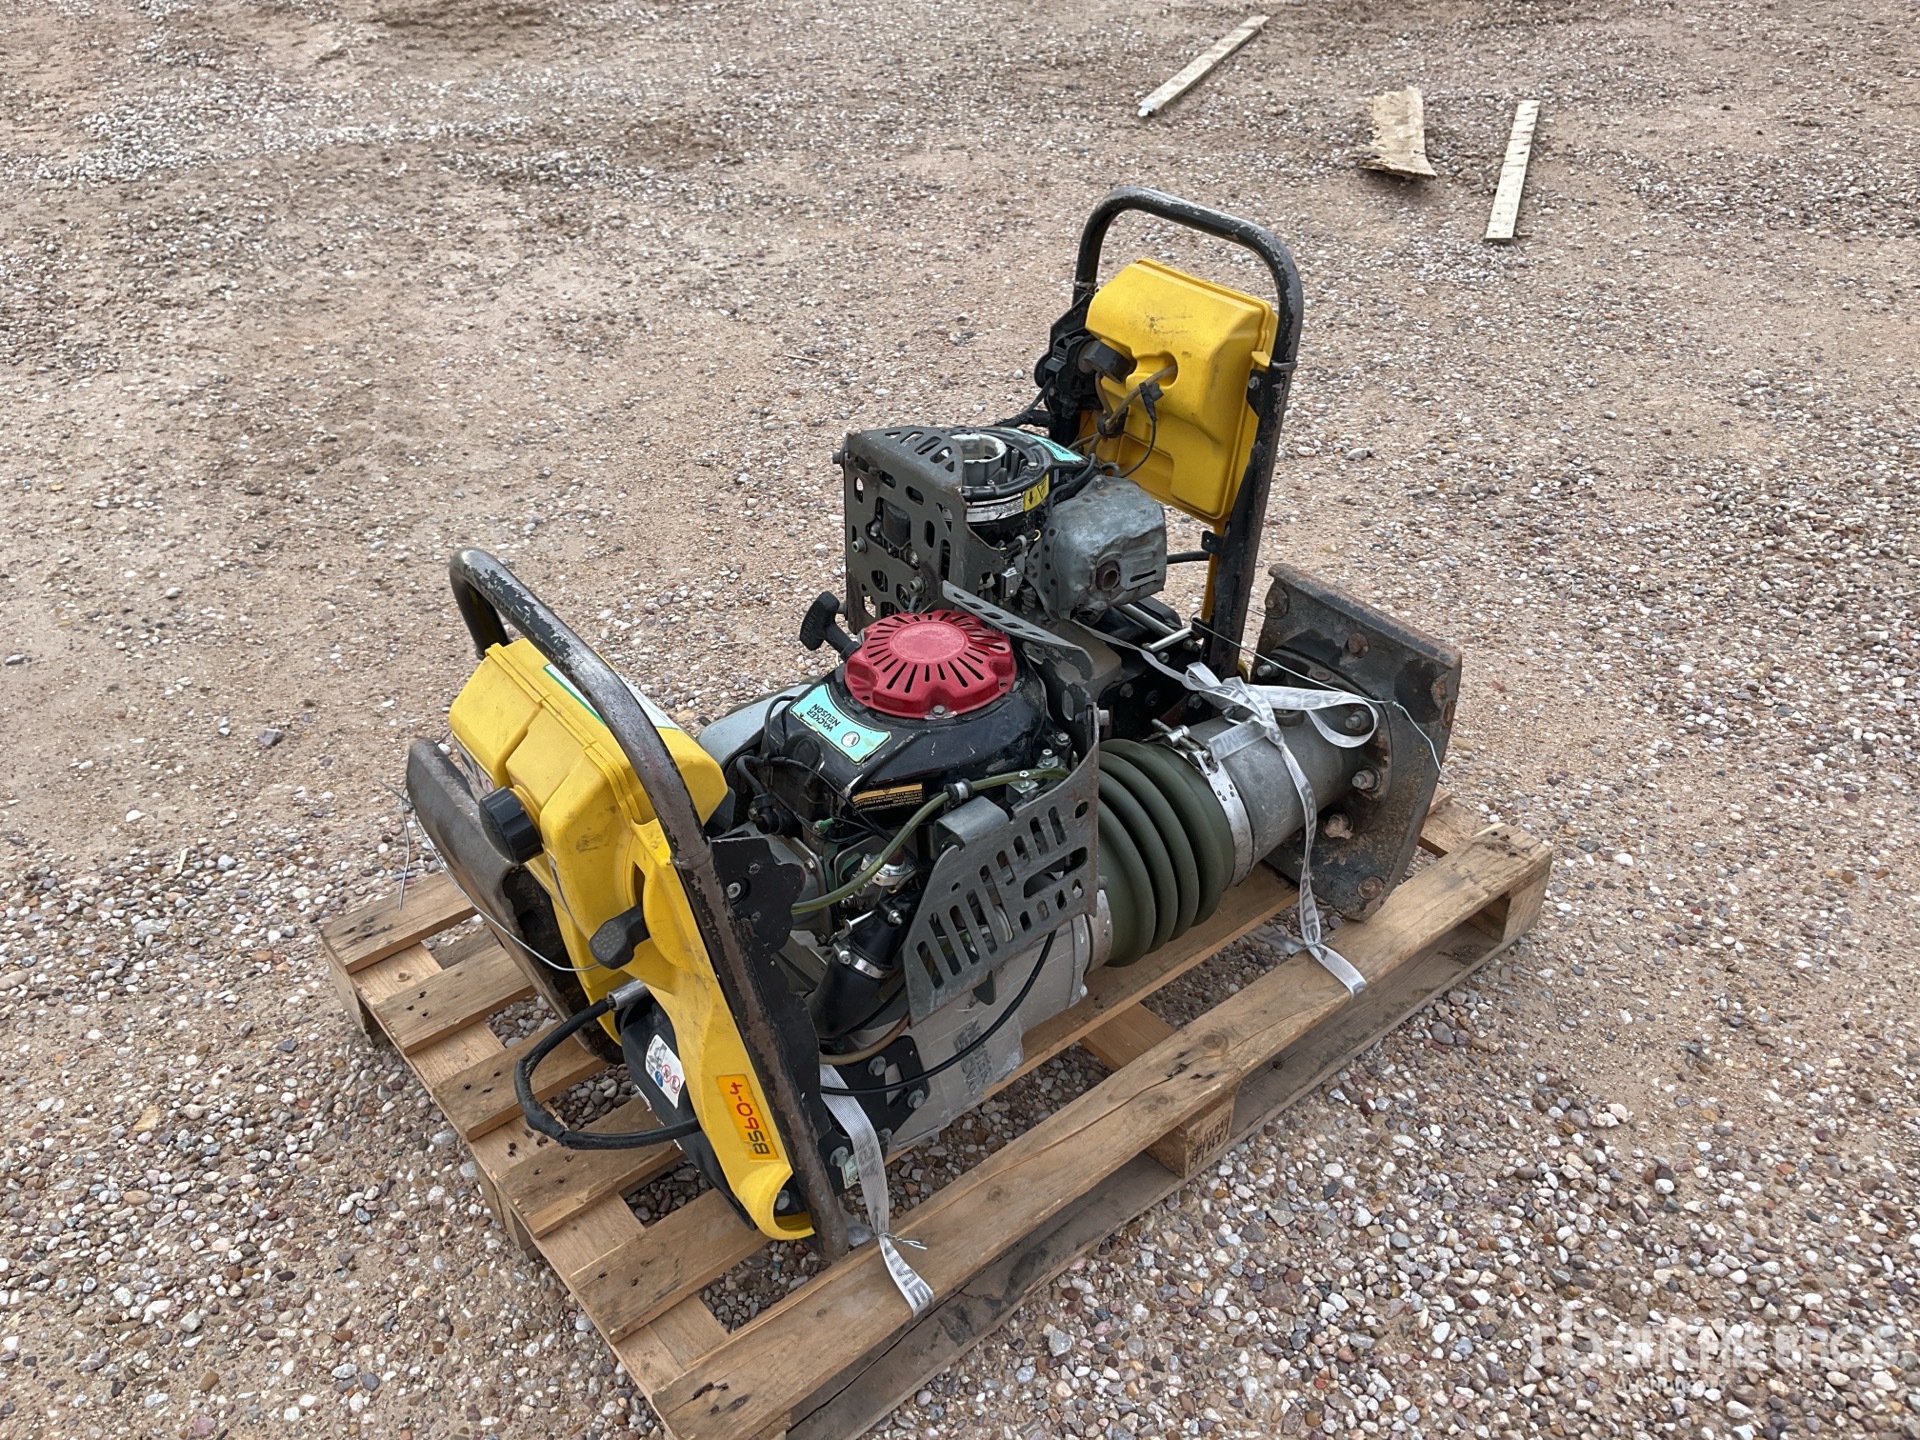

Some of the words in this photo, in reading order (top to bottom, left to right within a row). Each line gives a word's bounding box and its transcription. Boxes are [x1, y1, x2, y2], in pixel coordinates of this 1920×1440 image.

[806, 708, 834, 732] WACKER
[811, 703, 841, 728] NEUSON
[729, 1081, 771, 1155] BS60-4
